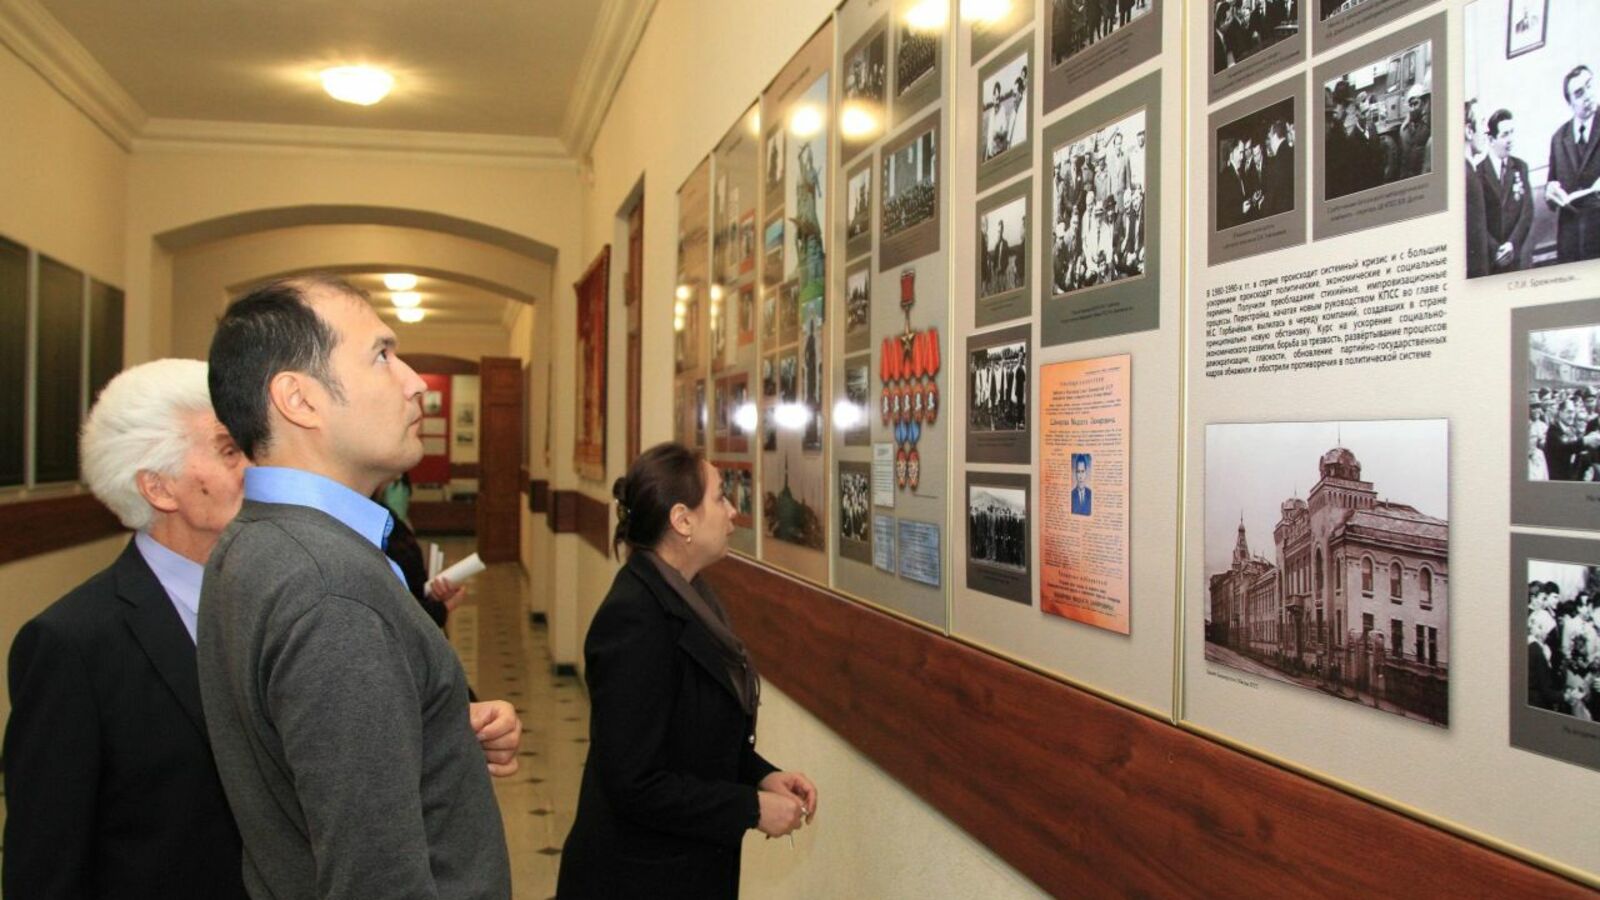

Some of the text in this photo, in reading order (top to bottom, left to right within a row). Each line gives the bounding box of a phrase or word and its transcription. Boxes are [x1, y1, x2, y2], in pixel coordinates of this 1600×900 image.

[1259, 276, 1278, 287] стране
[1281, 270, 1318, 283] происходит
[1321, 259, 1358, 275] системный
[1362, 255, 1387, 268] кризис
[1407, 244, 1447, 258] большим
[1206, 297, 1236, 309] ускорением
[1240, 289, 1272, 301] происходят
[1326, 269, 1381, 286] экономические
[1396, 257, 1447, 273] социальные
[1238, 302, 1266, 312] Получили
[1271, 293, 1315, 307] преобладание
[1367, 270, 1447, 291] импровизационные
[1273, 307, 1297, 316] начатая
[1300, 303, 1322, 312] новым
[1325, 295, 1375, 311] руководством
[1378, 288, 1399, 300] КПСС
[1402, 288, 1413, 297] во
[1416, 284, 1439, 295] главе
[1442, 283, 1447, 291] с
[1251, 333, 1270, 342] новую
[1317, 324, 1332, 336] Курс
[1339, 322, 1347, 330] на
[1353, 317, 1392, 330] ускорение
[1399, 310, 1447, 323] социально-
[1257, 320, 1285, 330] вылилась
[1296, 315, 1318, 326] череду
[1363, 302, 1405, 315] создавших
[1410, 301, 1414, 309] в
[1419, 297, 1447, 308] стране
[1206, 346, 1248, 358] экономического
[1277, 339, 1299, 350] борьба
[1403, 323, 1447, 336] процессов
[1293, 348, 1333, 359] обновление
[1340, 336, 1447, 353] партийно-государственных
[1258, 363, 1290, 374] обострили
[1291, 360, 1337, 371] противоречия
[1339, 358, 1343, 366] в
[1345, 351, 1397, 366] политической
[1399, 351, 1432, 361] системе
